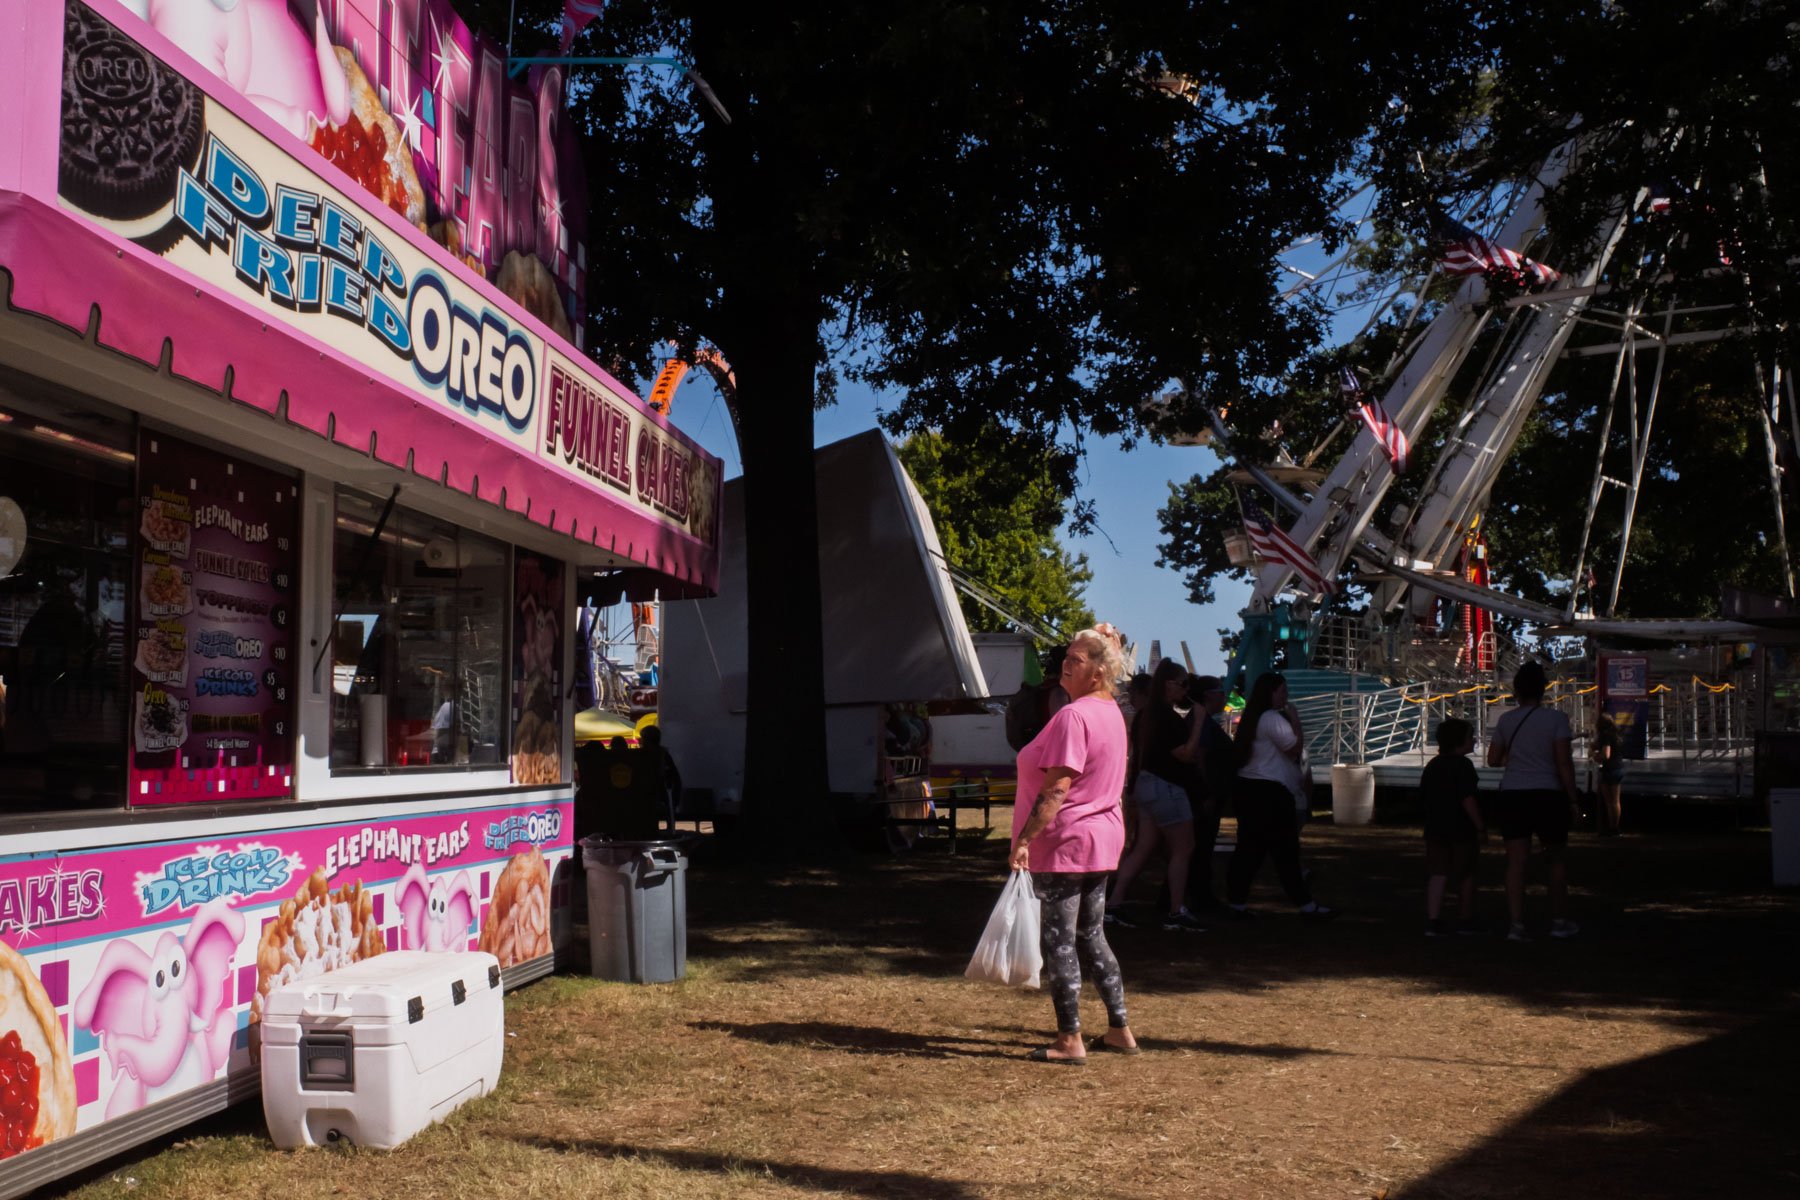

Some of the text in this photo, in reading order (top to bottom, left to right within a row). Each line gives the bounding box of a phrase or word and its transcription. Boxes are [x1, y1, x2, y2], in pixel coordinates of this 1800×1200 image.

[81, 57, 145, 80] OREO
[438, 32, 562, 268] EARS
[206, 130, 407, 298] DEEP
[173, 166, 412, 359] FRIED
[407, 274, 534, 430] OREO
[546, 361, 691, 524] FUNNEL CAKES
[195, 504, 242, 538] ELEPHANT
[245, 521, 269, 543] EARS
[195, 549, 235, 579] FUNNEL
[236, 558, 270, 584] CAKES
[277, 573, 288, 588] $10
[196, 588, 269, 616] TOPPINGS
[277, 609, 286, 625] $2
[138, 628, 149, 640] $15
[235, 638, 286, 661] OREO $10
[196, 672, 276, 697] DRINKS $5
[204, 668, 254, 684] ICE COLD
[276, 687, 286, 702] $8
[276, 721, 285, 735] $2
[485, 829, 528, 850] FRIED
[488, 816, 528, 836] DEEP
[527, 810, 560, 844] OREO
[165, 848, 280, 880] ICE COLD
[325, 821, 469, 879] ELEPHANT EARS
[144, 860, 290, 914] DRINKS
